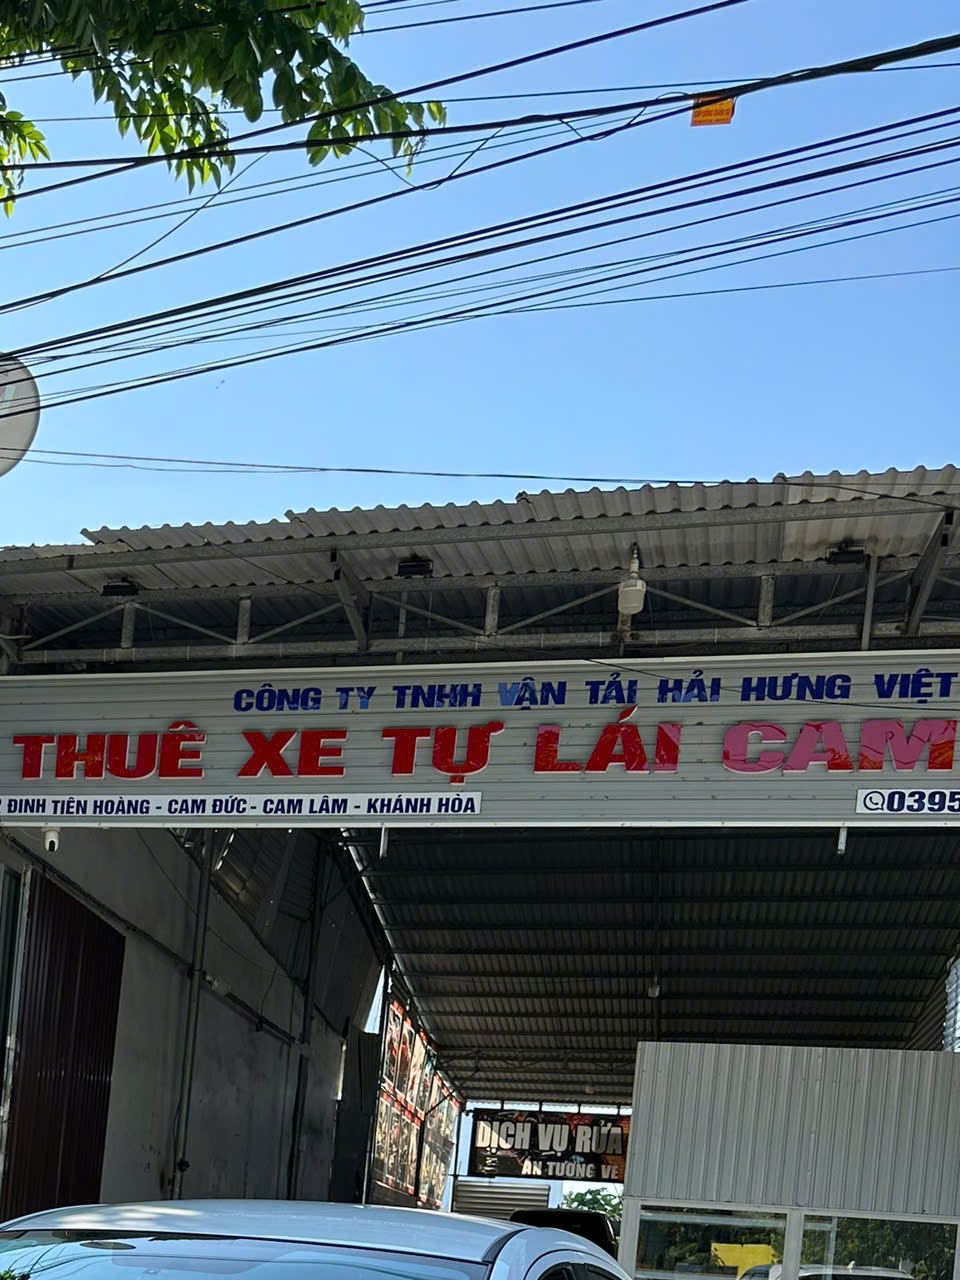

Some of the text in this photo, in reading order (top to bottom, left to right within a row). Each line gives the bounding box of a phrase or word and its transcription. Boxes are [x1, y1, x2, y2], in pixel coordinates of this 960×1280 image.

[233, 668, 959, 712] CÔNG TY TNHH VẬN TẢI HẢI HƯNG VIỆT
[12, 704, 957, 785] THUÊ XE TỰ LÁI CAM
[7, 798, 47, 814] ĐINH
[51, 796, 87, 815] TIÊN
[92, 796, 151, 815] HOÀNG
[167, 798, 206, 815] CAM
[211, 795, 248, 814] ĐỨC
[262, 798, 303, 814] CAM
[308, 795, 348, 814] LÂM
[366, 794, 432, 814] KHÁNH
[437, 793, 476, 814] HÒA
[475, 1119, 623, 1157] DỊCH VỤ RỬA
